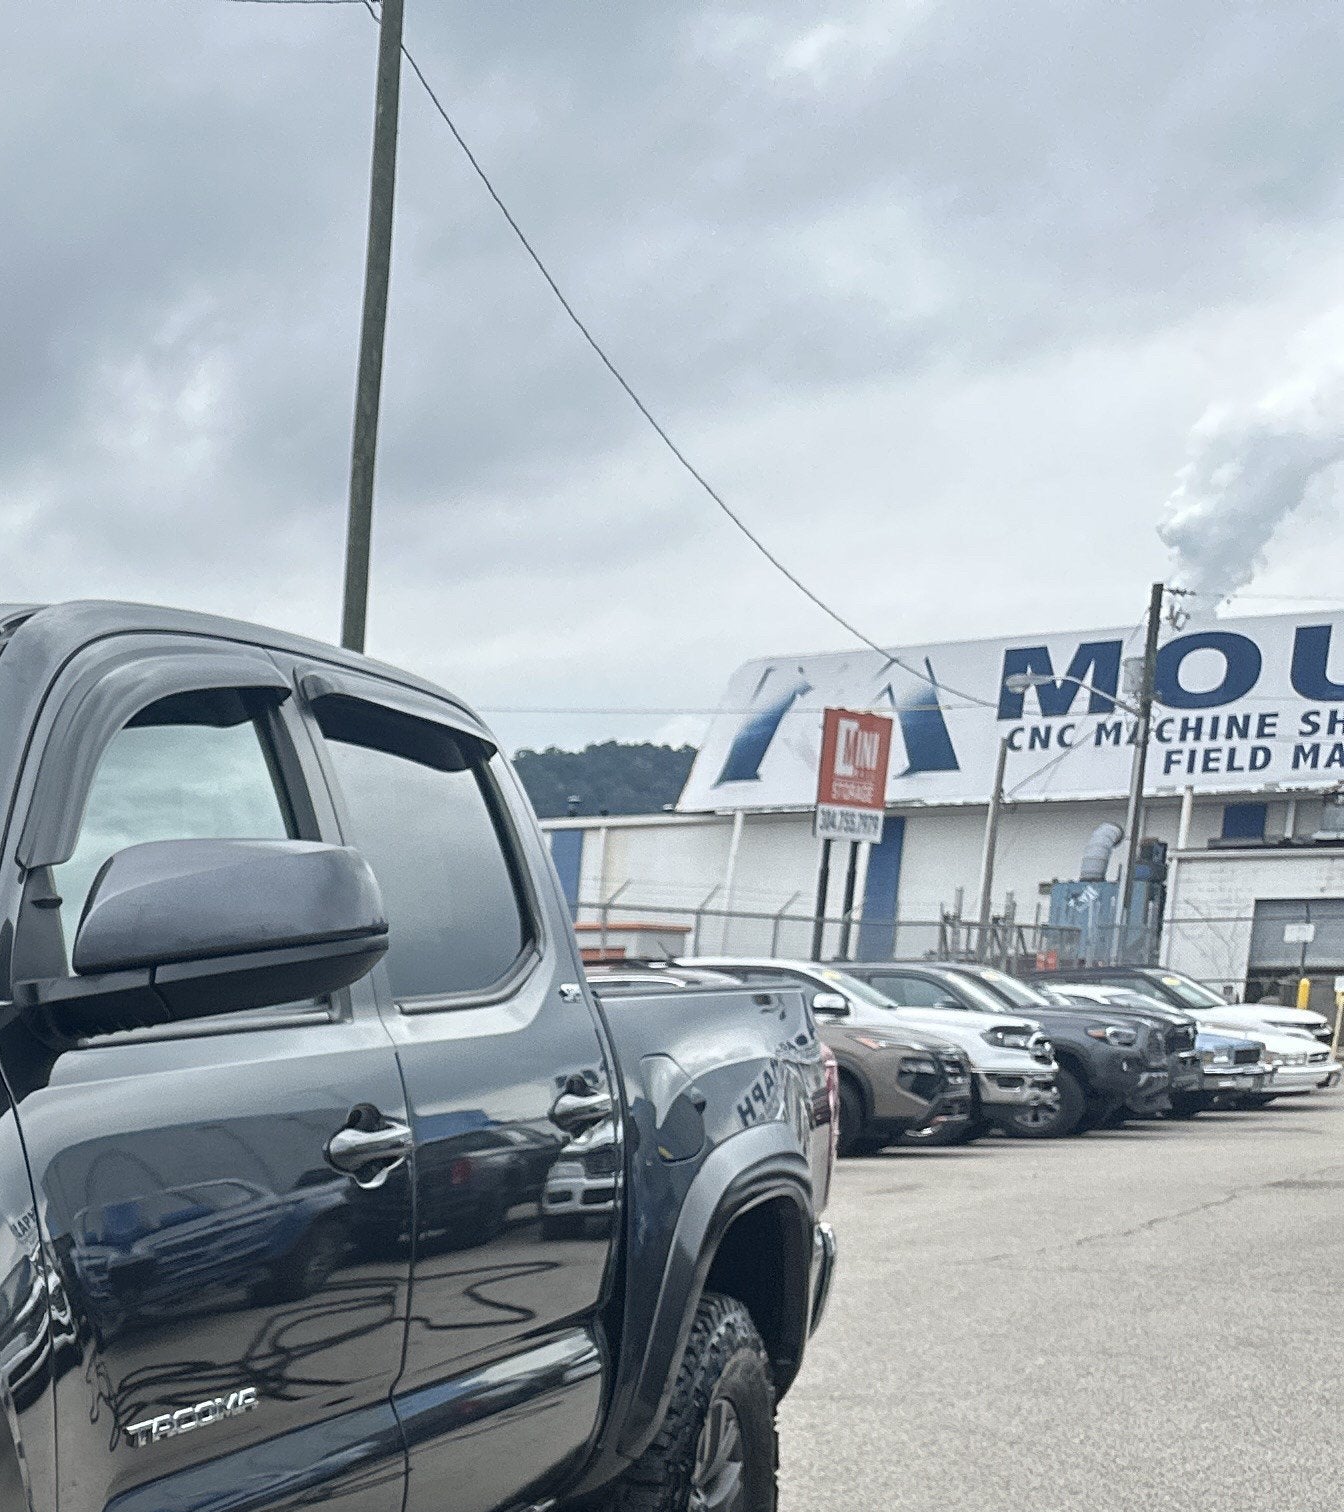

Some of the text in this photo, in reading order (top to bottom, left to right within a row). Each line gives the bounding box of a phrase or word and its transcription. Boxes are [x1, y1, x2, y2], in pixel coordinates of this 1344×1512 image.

[1006, 724, 1075, 751] CNC
[1164, 745, 1272, 774] FIELD
[122, 1386, 259, 1446] TACOMA
